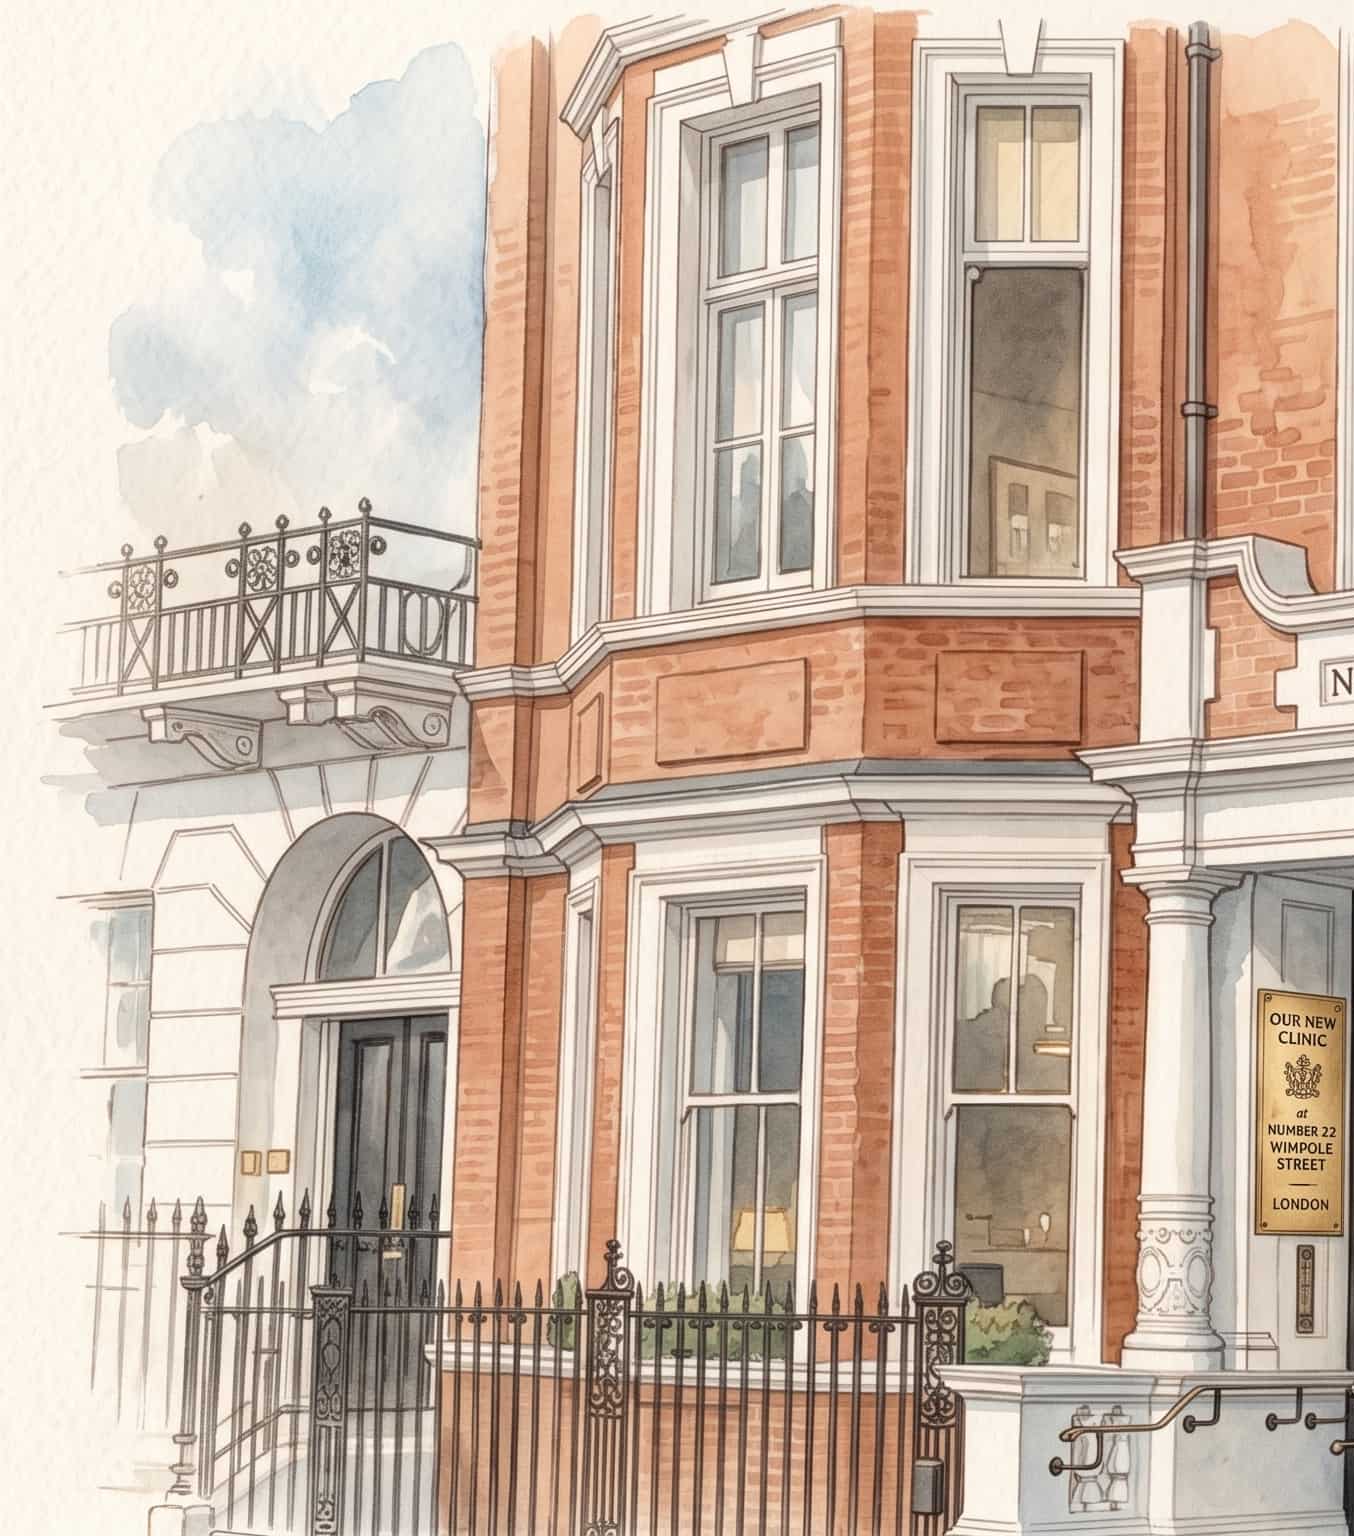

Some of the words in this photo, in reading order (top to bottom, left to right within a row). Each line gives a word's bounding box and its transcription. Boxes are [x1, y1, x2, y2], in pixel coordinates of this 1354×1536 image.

[1270, 1012, 1301, 1027] OUR
[1305, 1015, 1336, 1030] NEW
[1278, 1030, 1328, 1047] CLINIC
[1296, 1108, 1308, 1119] at
[1268, 1124, 1318, 1137] NUMBER
[1321, 1126, 1337, 1138] 22
[1270, 1141, 1333, 1155] WIMPOLE
[1277, 1157, 1326, 1171] STREET
[1272, 1197, 1329, 1211] LONDON
